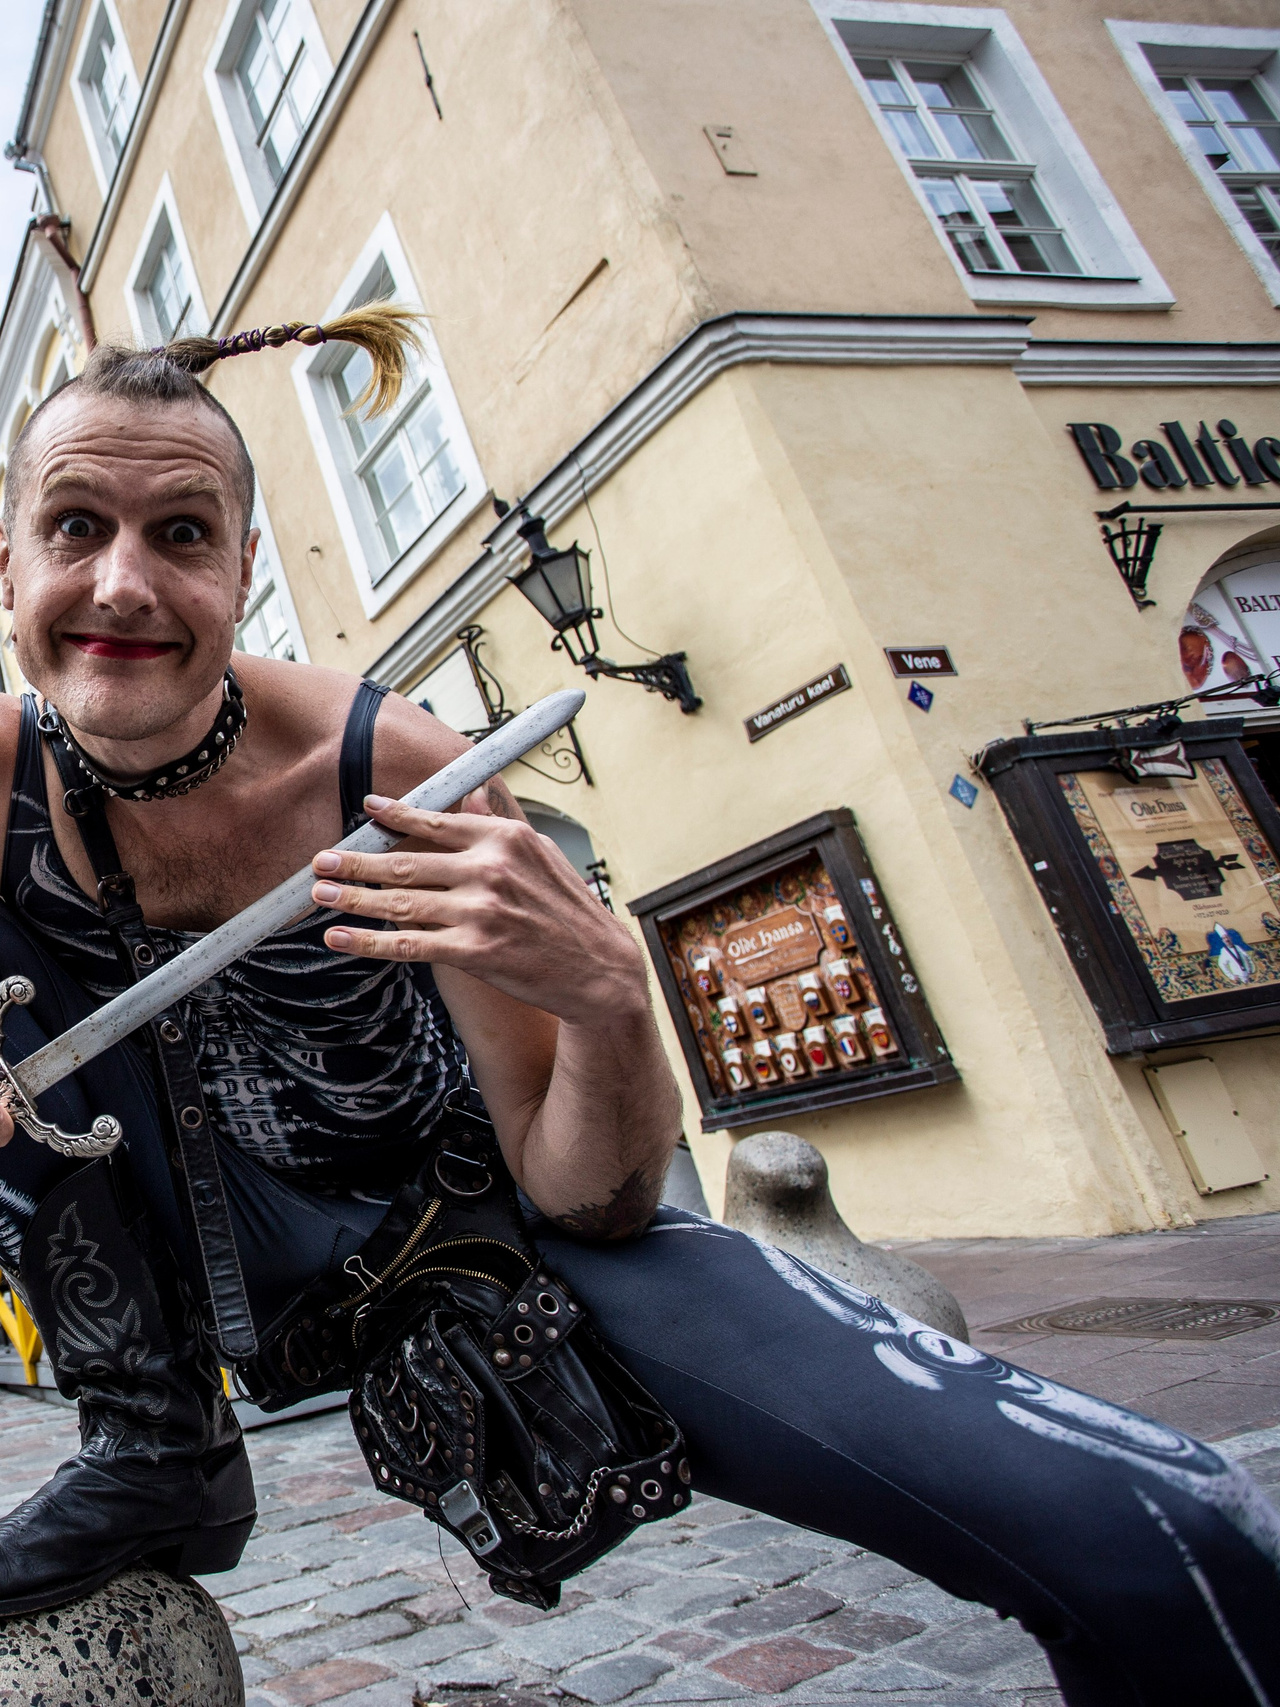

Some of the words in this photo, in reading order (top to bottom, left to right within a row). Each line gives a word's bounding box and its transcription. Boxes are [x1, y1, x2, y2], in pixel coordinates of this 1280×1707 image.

[901, 653, 942, 670] Vene
[753, 695, 805, 728] Vanaturu
[807, 674, 835, 699] kael
